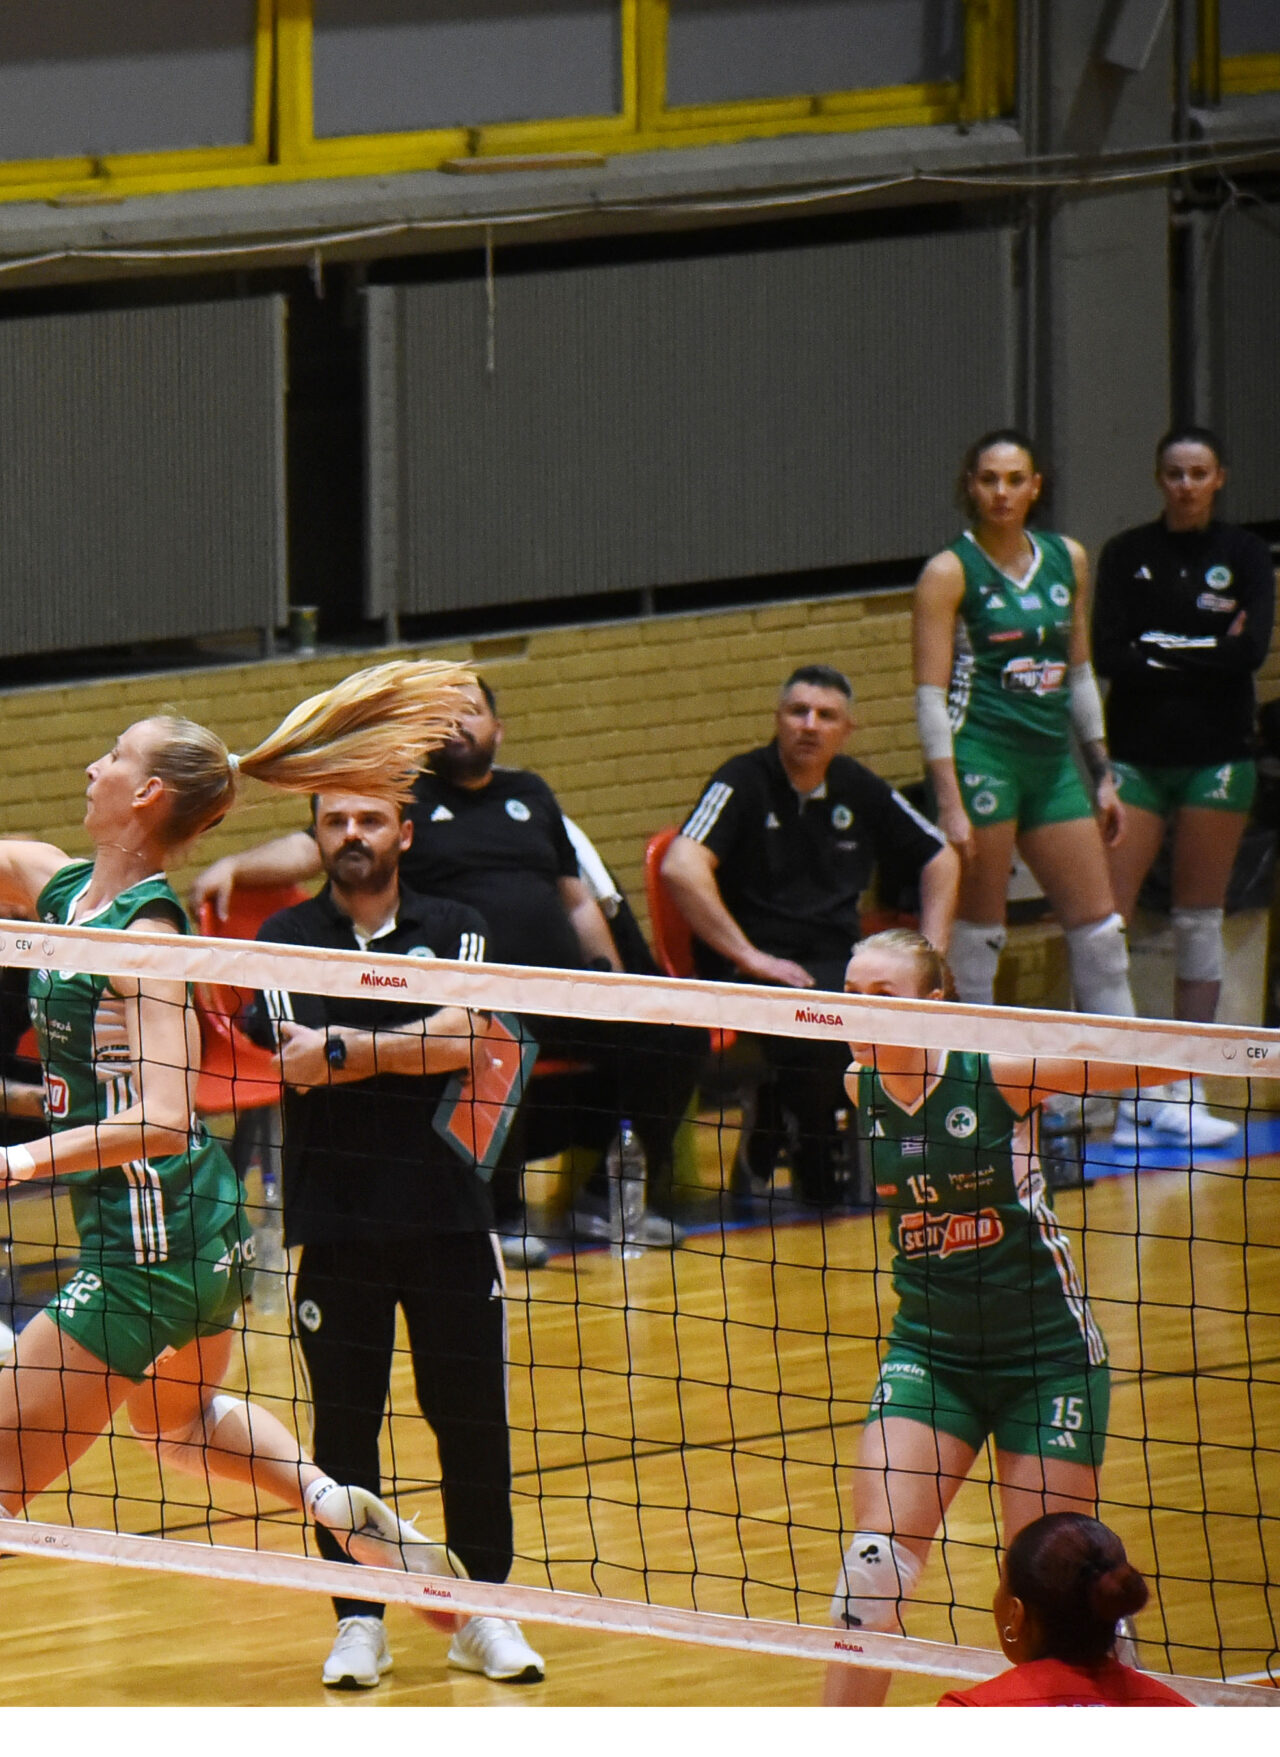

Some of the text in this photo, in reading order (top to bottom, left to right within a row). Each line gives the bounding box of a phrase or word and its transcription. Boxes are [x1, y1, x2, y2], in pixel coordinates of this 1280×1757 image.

[15, 939, 33, 950] CEV
[1246, 1046, 1269, 1059] CEV
[906, 1174, 939, 1204] 15
[1051, 1395, 1083, 1430] 15
